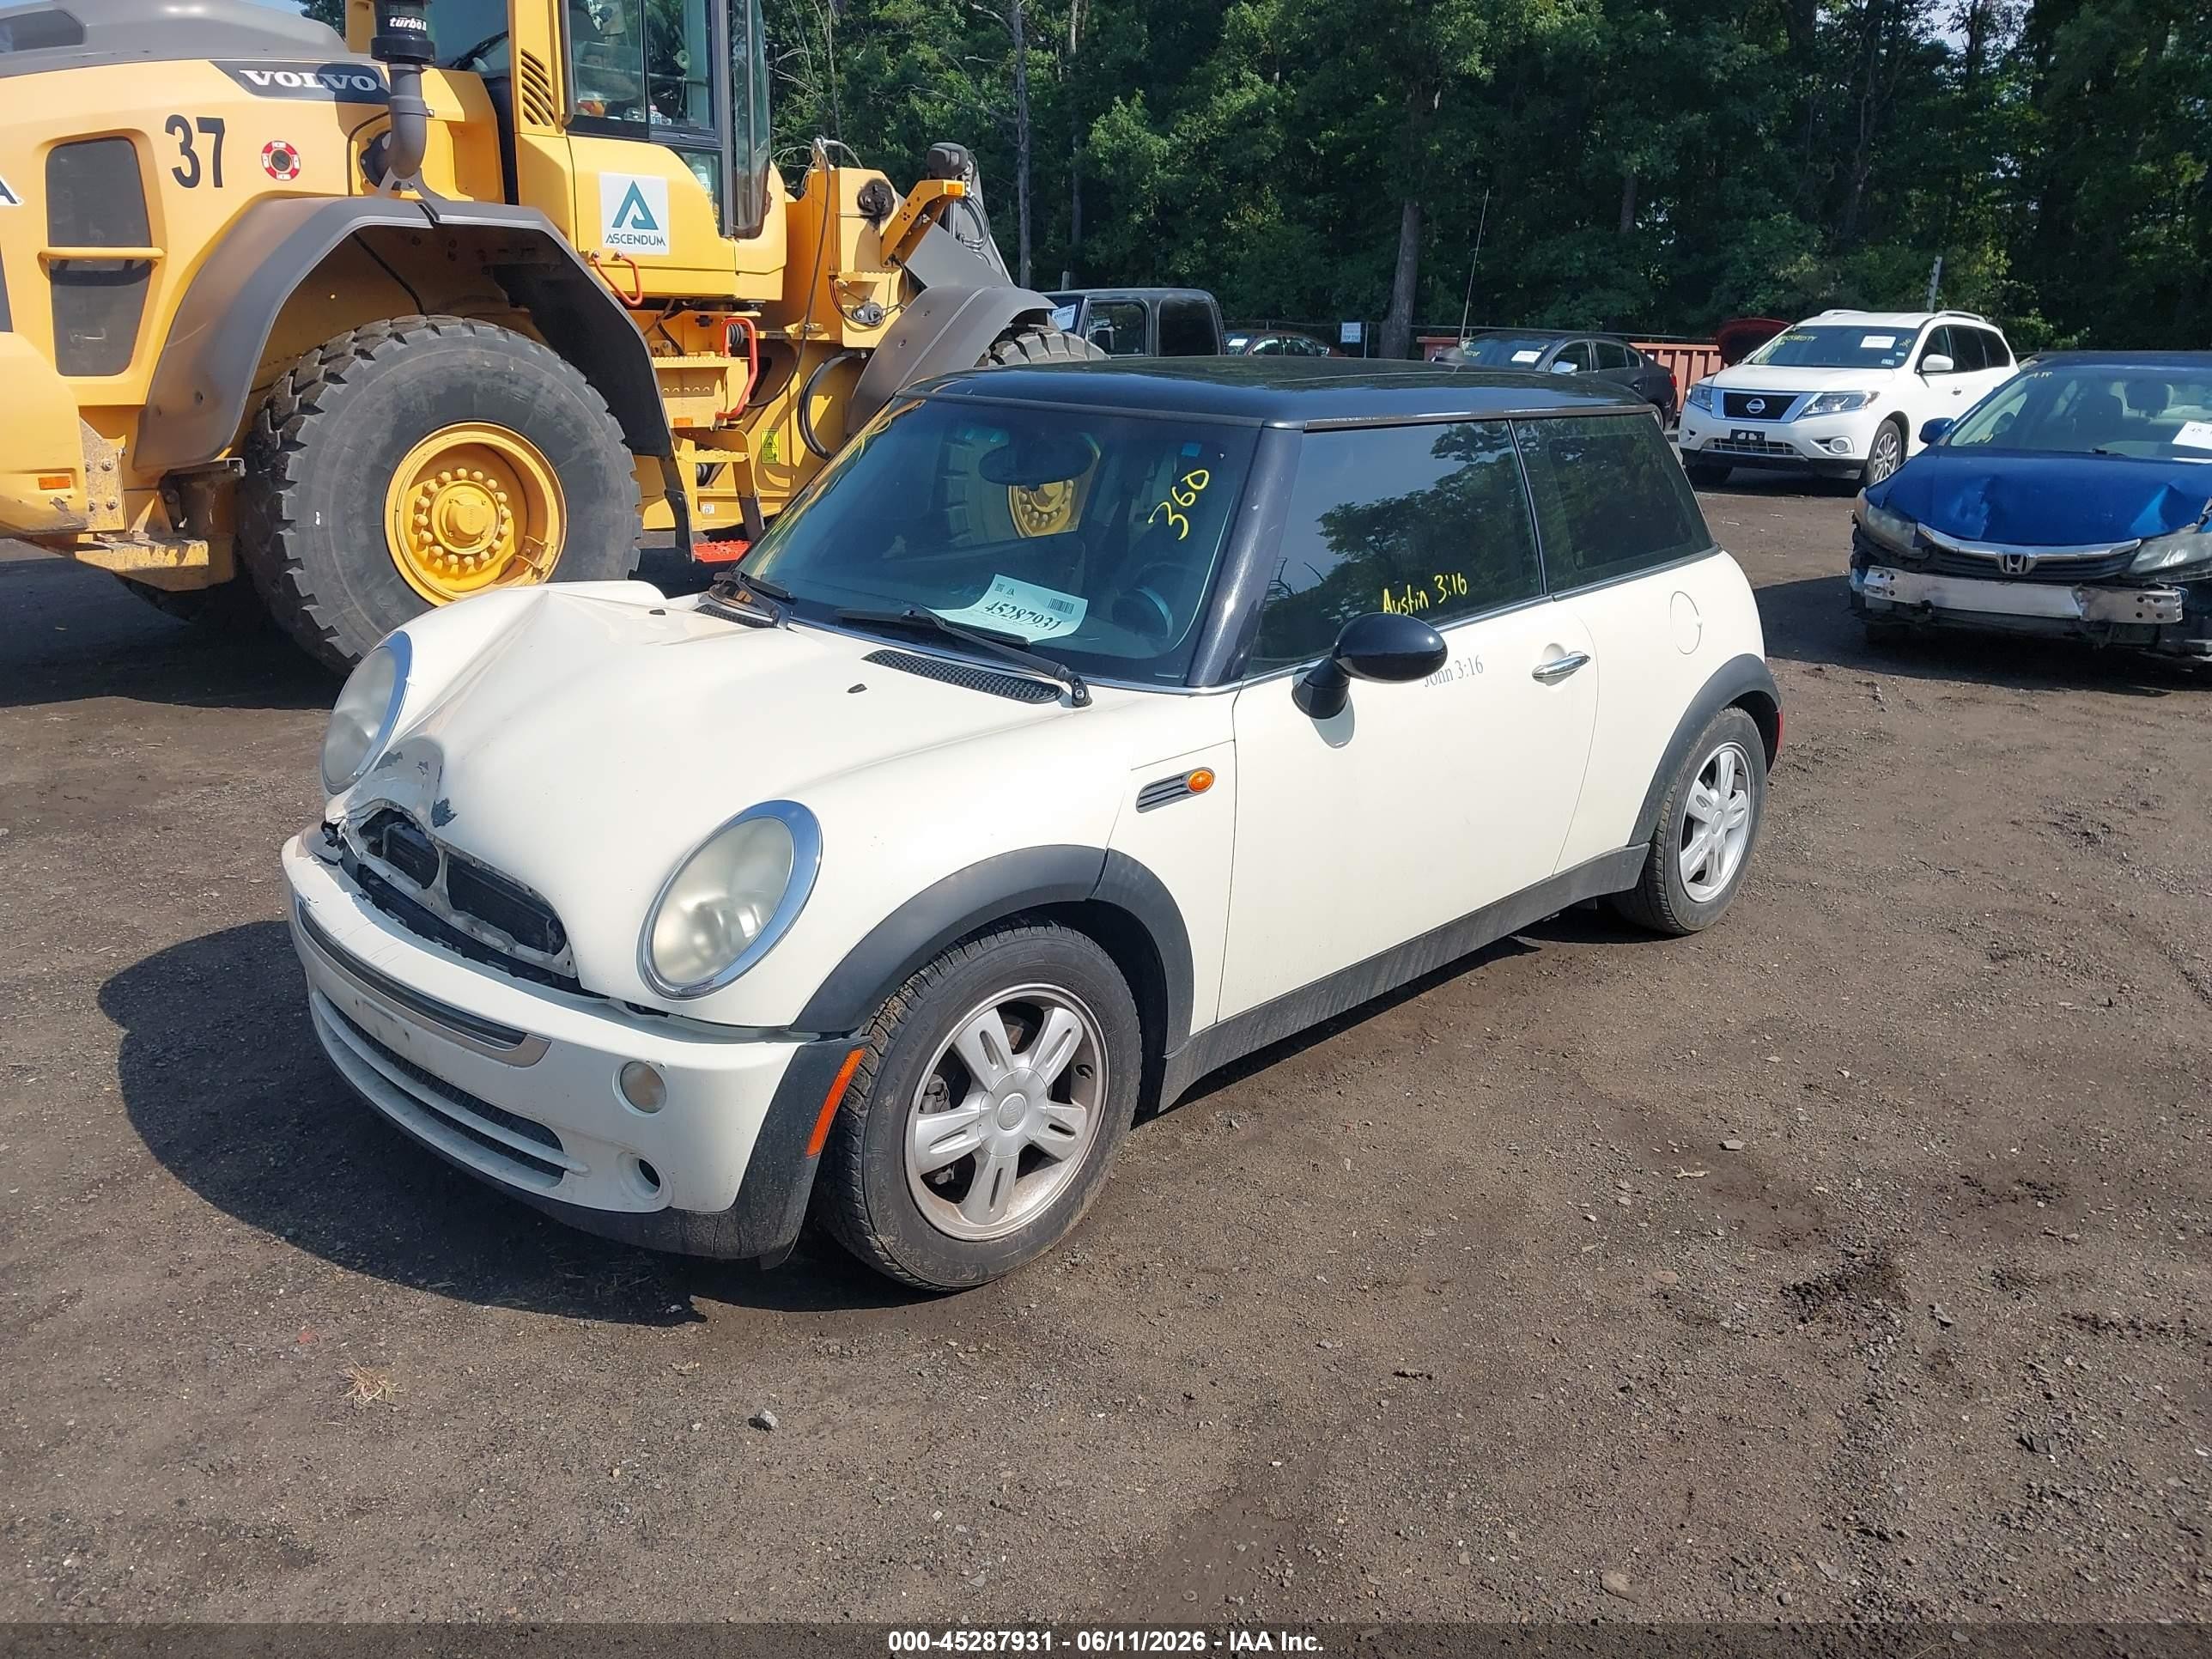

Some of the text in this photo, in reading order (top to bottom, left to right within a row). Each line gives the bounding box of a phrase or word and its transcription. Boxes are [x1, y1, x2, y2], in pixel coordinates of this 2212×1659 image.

[239, 70, 378, 92] VOLVO
[165, 114, 225, 189] 37
[605, 233, 666, 246] ASCENDUM
[1147, 469, 1210, 540] 360
[1382, 572, 1468, 616] Austin 3:16
[984, 600, 1062, 631] 45287931
[1455, 654, 1484, 680] 3:16
